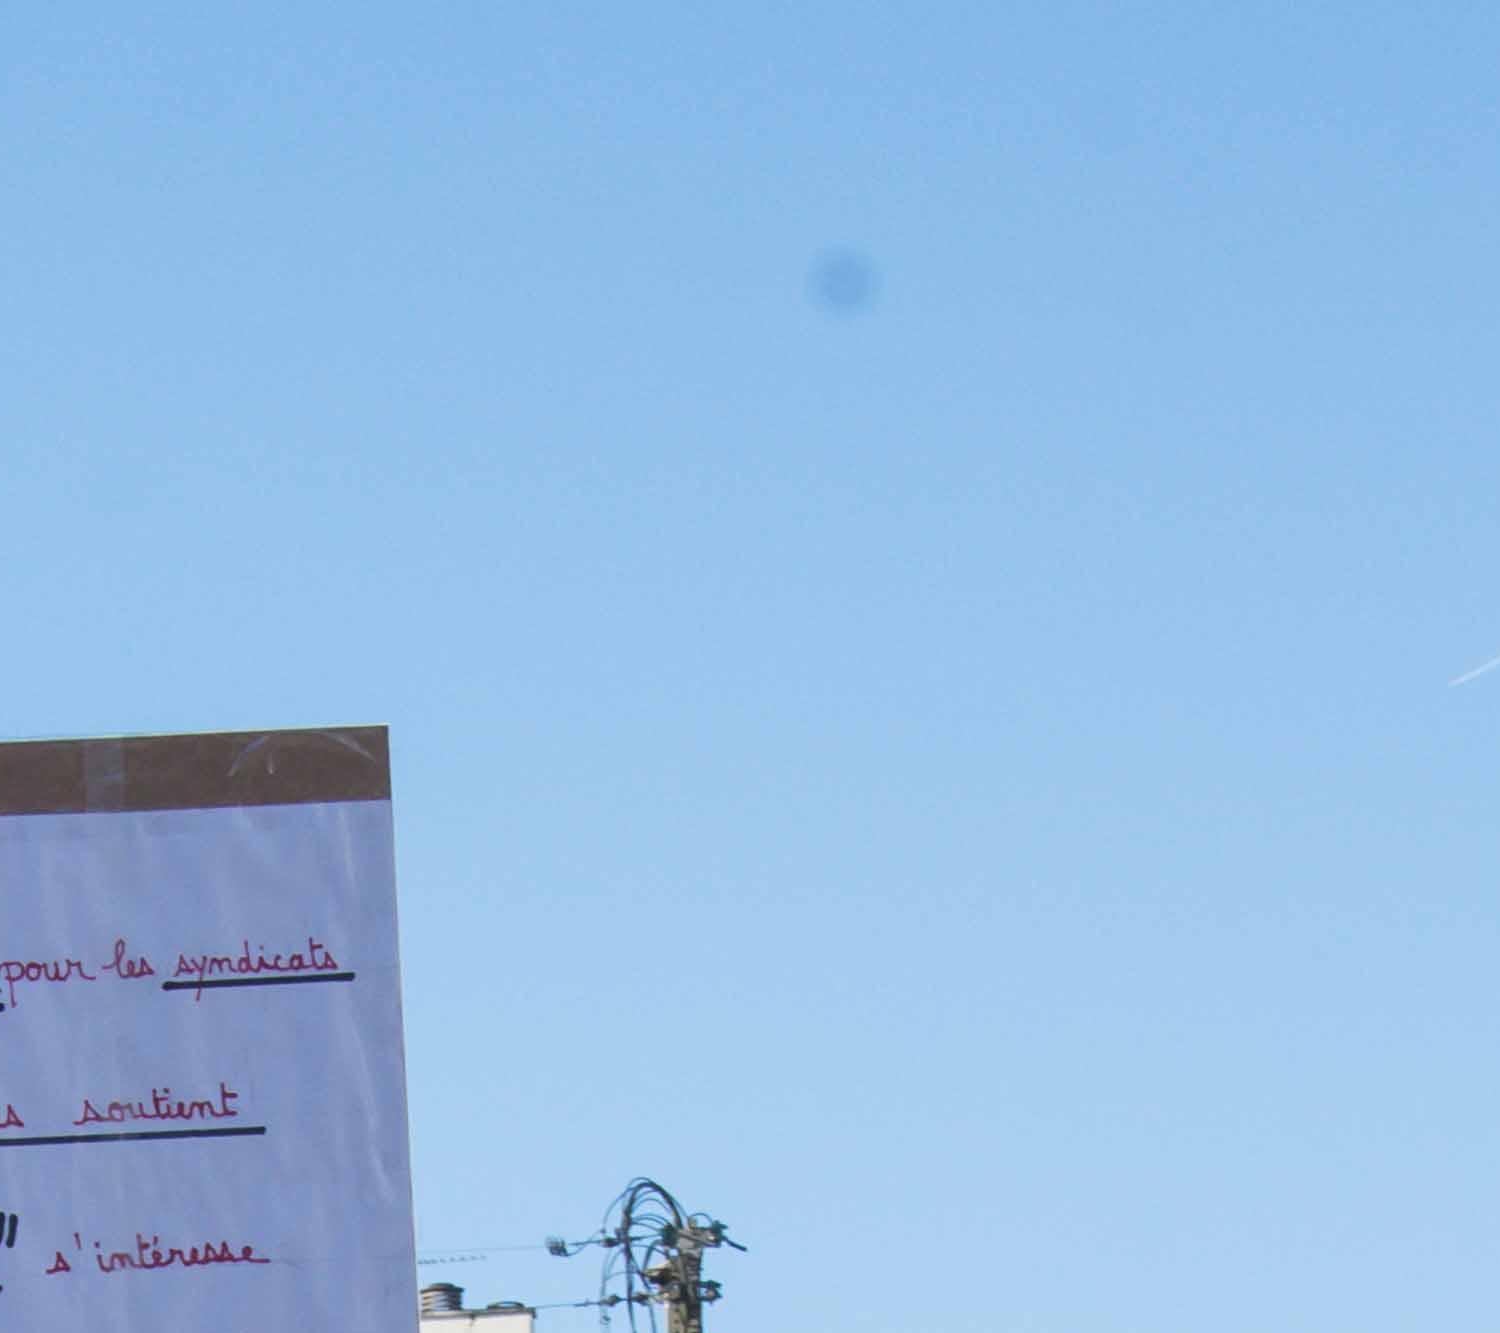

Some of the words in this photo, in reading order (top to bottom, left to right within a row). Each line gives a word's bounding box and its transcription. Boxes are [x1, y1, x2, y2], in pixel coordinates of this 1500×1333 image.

[101, 936, 156, 978] les
[171, 937, 339, 1002] syndicats
[72, 1082, 239, 1126] soutient
[45, 1231, 272, 1275] s'intéresse
